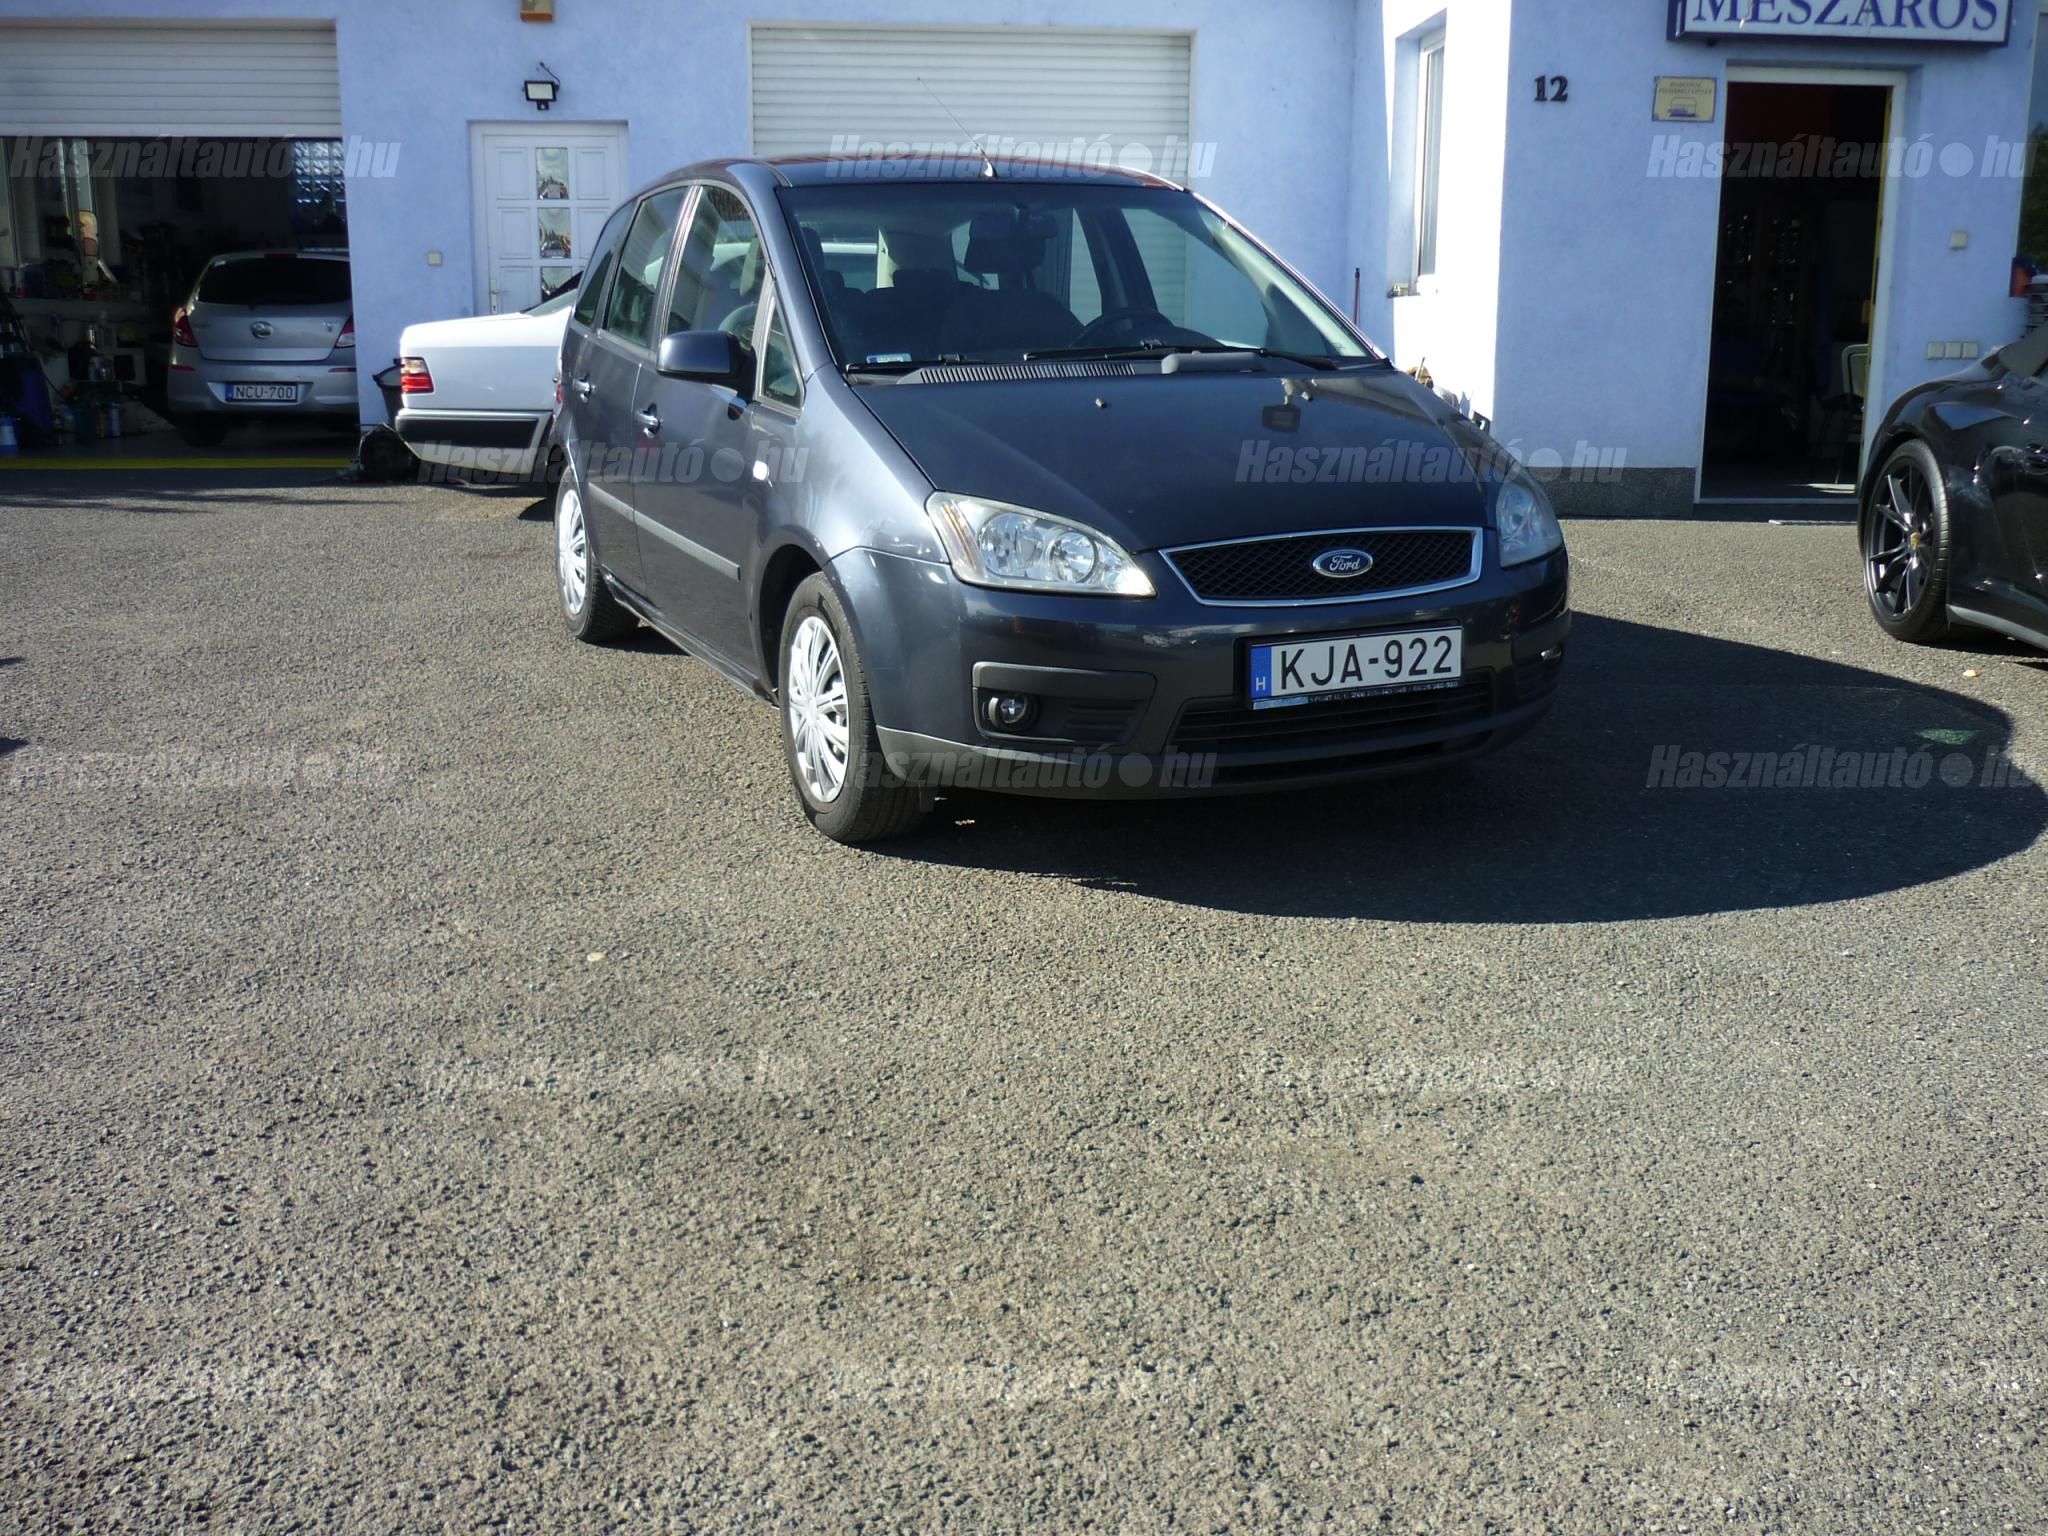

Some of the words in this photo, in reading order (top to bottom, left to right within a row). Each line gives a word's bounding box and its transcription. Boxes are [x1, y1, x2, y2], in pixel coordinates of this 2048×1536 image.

[1534, 75, 1568, 102] 12
[235, 386, 293, 398] NCU-700
[1329, 555, 1361, 571] Ford
[1281, 635, 1453, 690] KJA-922
